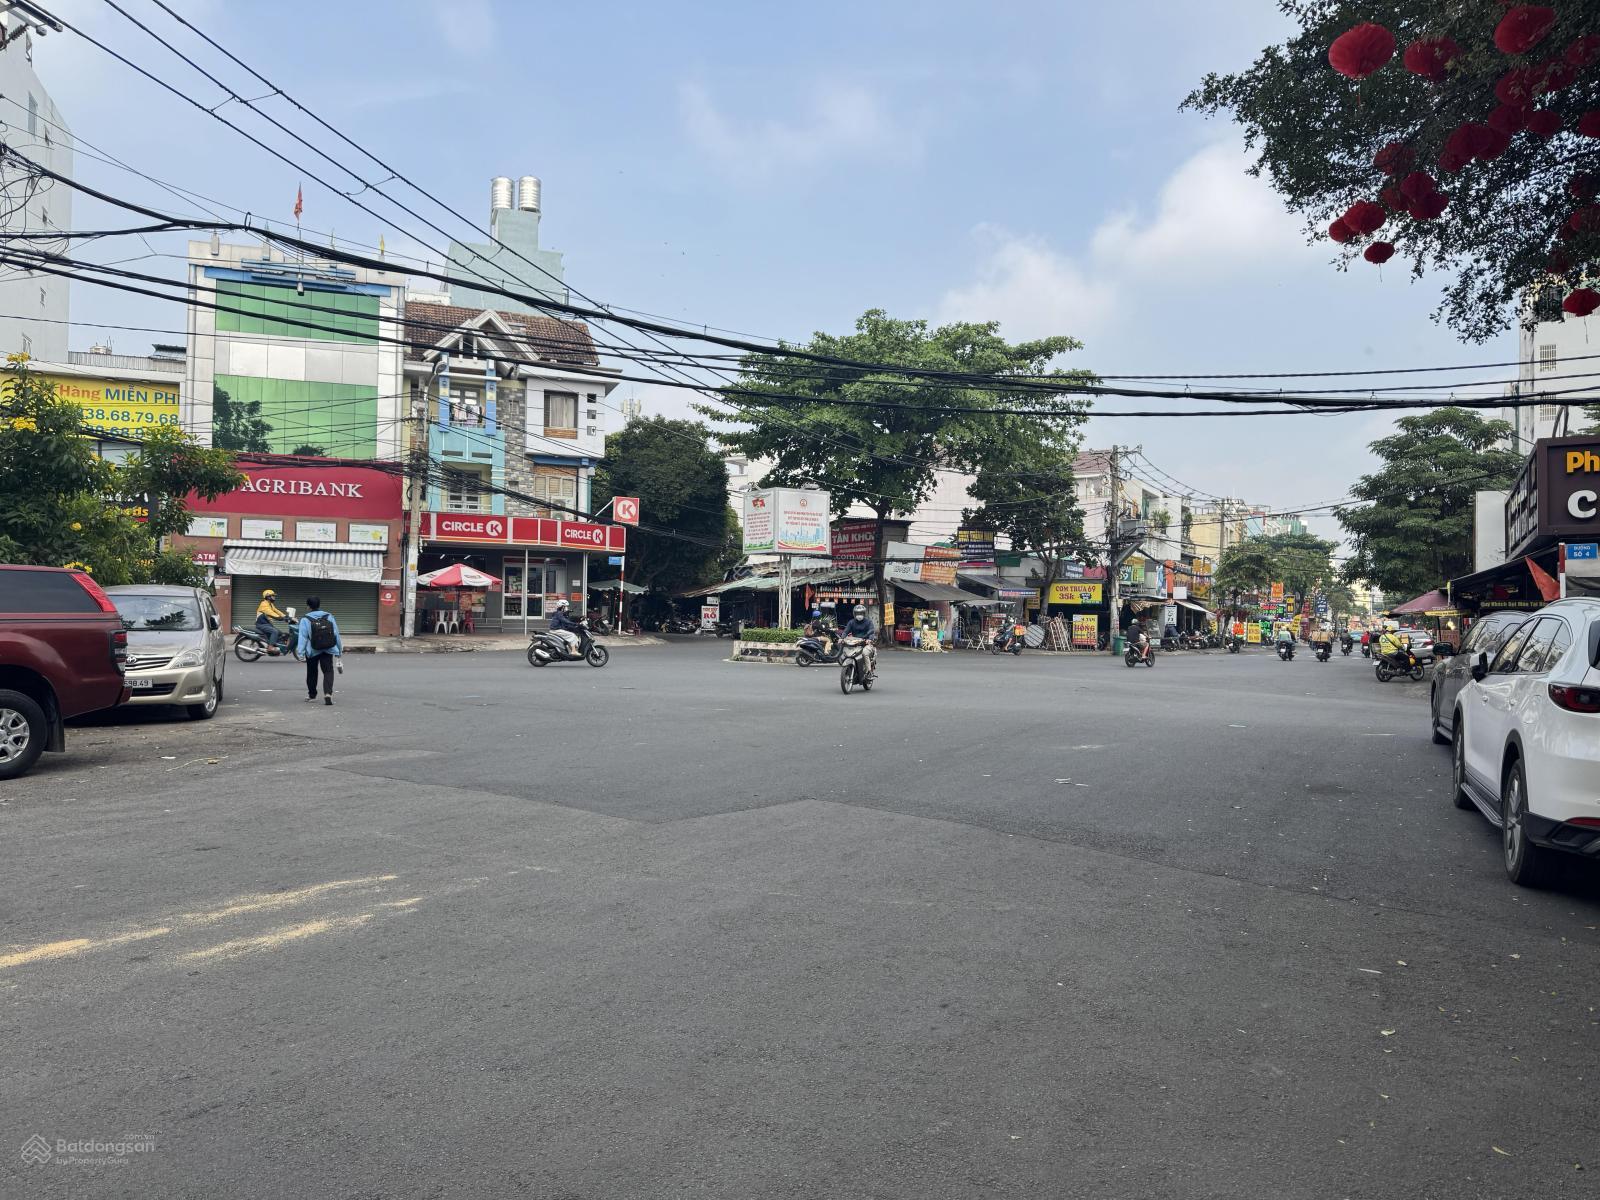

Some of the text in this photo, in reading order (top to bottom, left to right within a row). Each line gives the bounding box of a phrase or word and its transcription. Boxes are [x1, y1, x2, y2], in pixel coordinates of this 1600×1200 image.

[59, 384, 101, 401] Hàng
[241, 478, 364, 498] AGRIBANK
[620, 502, 635, 518] K
[441, 520, 501, 535] CIRCLE K
[564, 528, 602, 543] CIRCLE K
